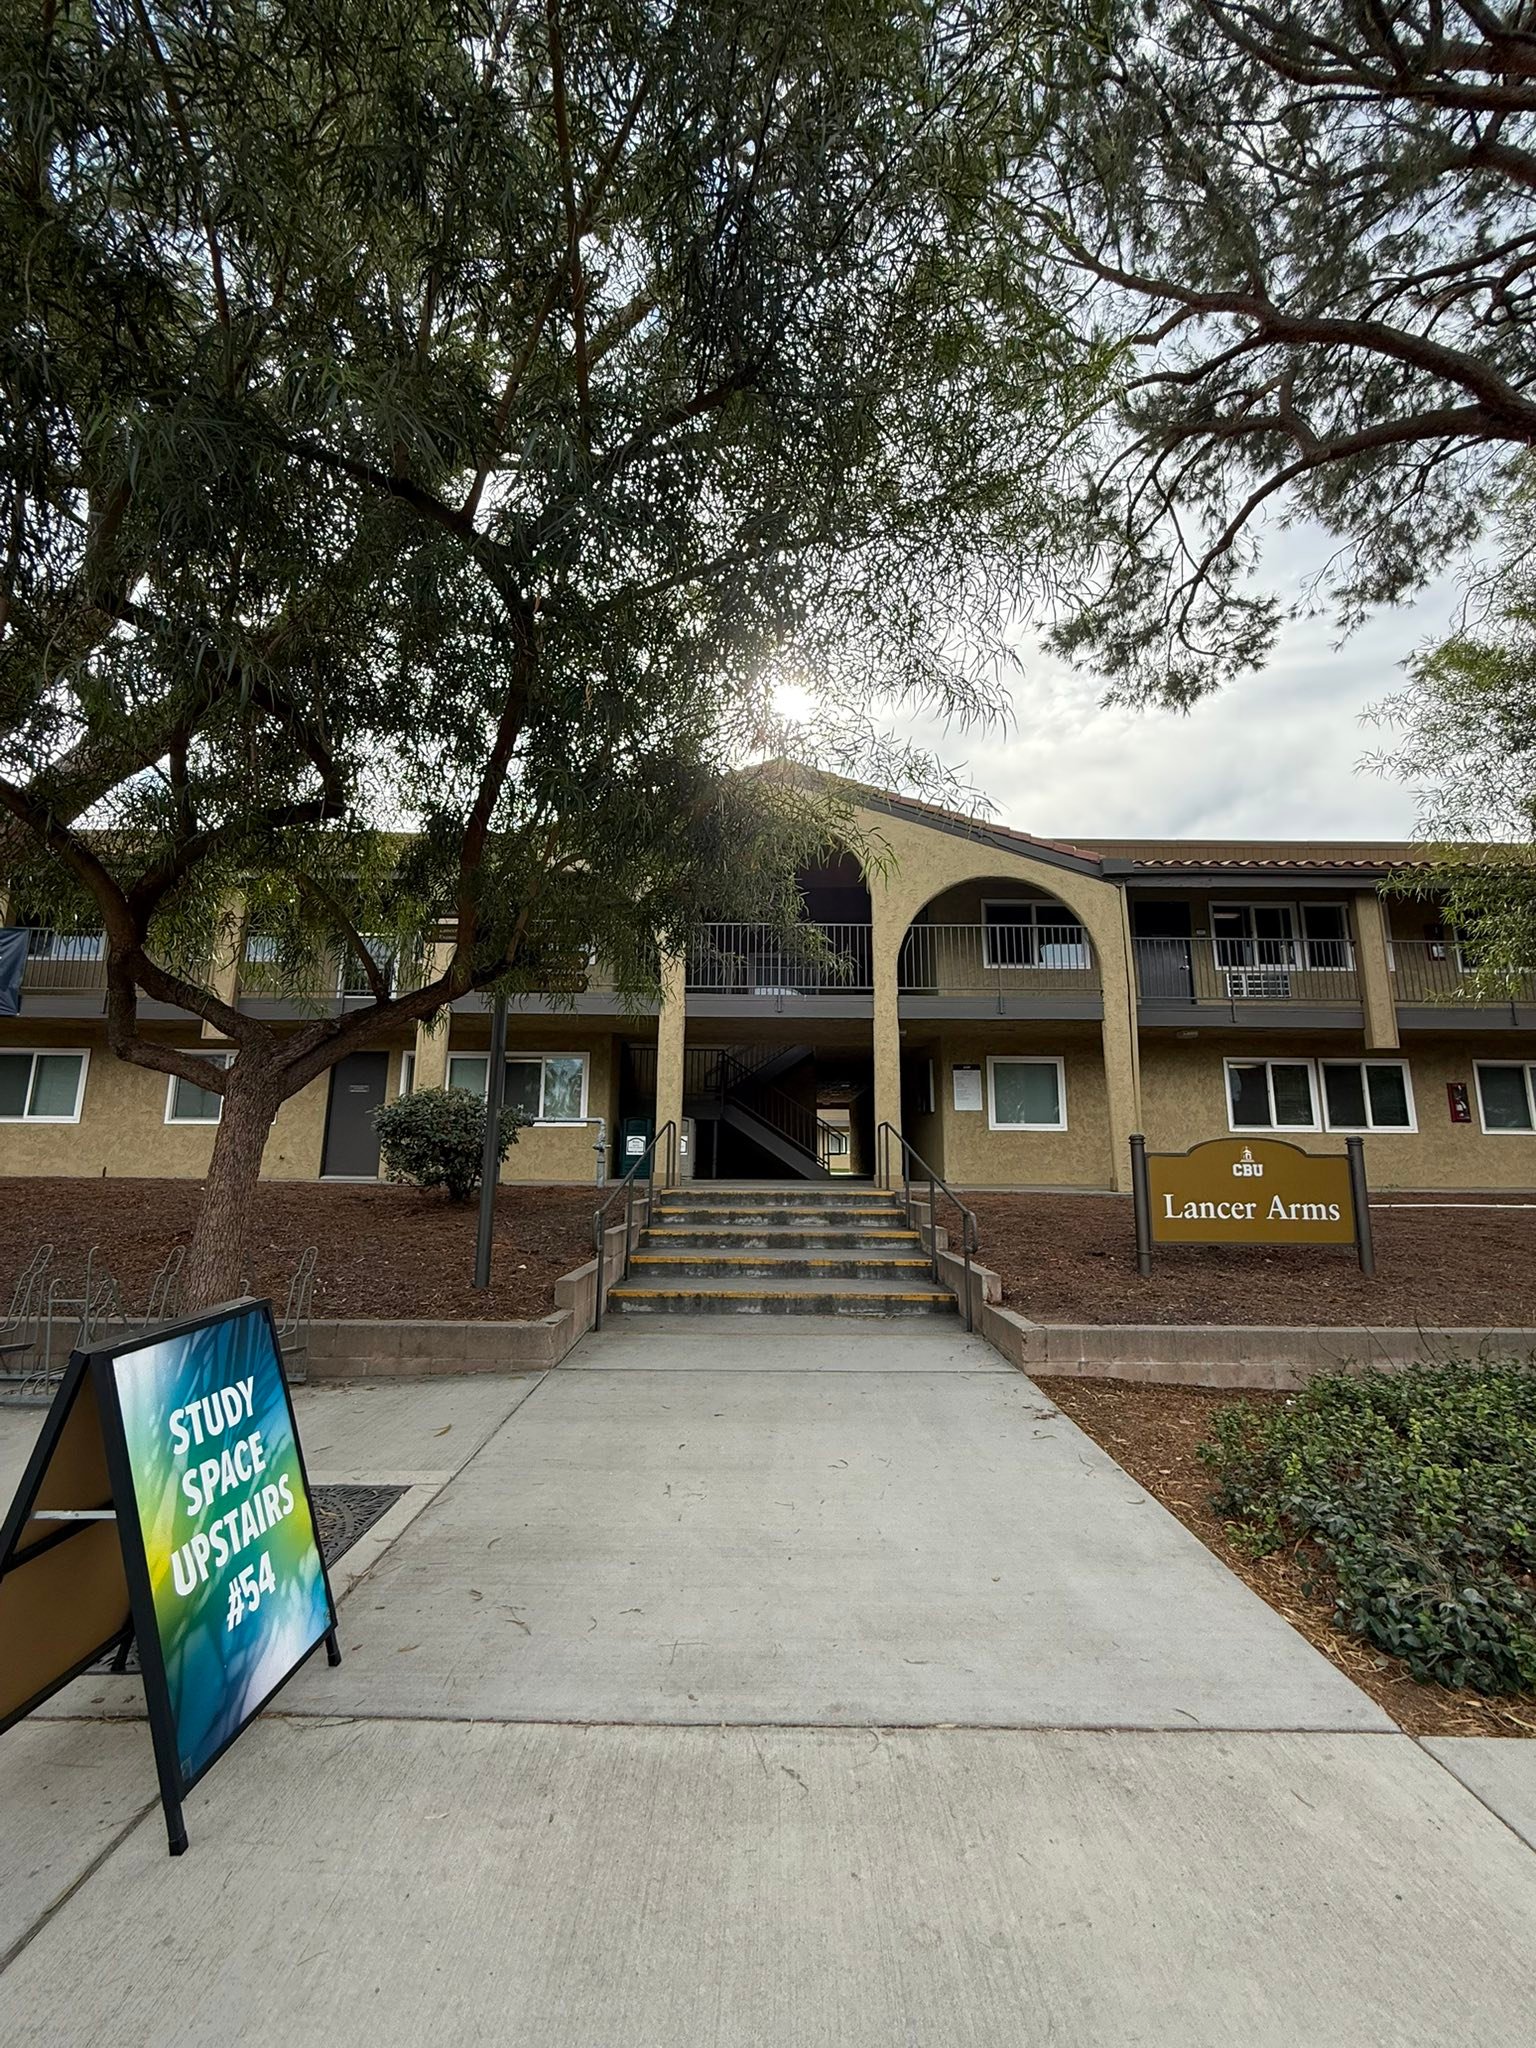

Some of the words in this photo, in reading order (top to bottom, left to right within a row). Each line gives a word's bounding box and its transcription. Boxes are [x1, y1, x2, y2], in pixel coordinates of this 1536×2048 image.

[1163, 1194, 1256, 1220] Lancer
[1266, 1194, 1341, 1222] Arms
[1232, 1163, 1264, 1177] CBU
[169, 1376, 255, 1455] STUDY
[182, 1430, 267, 1517] SPACE
[170, 1473, 294, 1596] UPSTAIRS
[226, 1550, 276, 1632] #54
